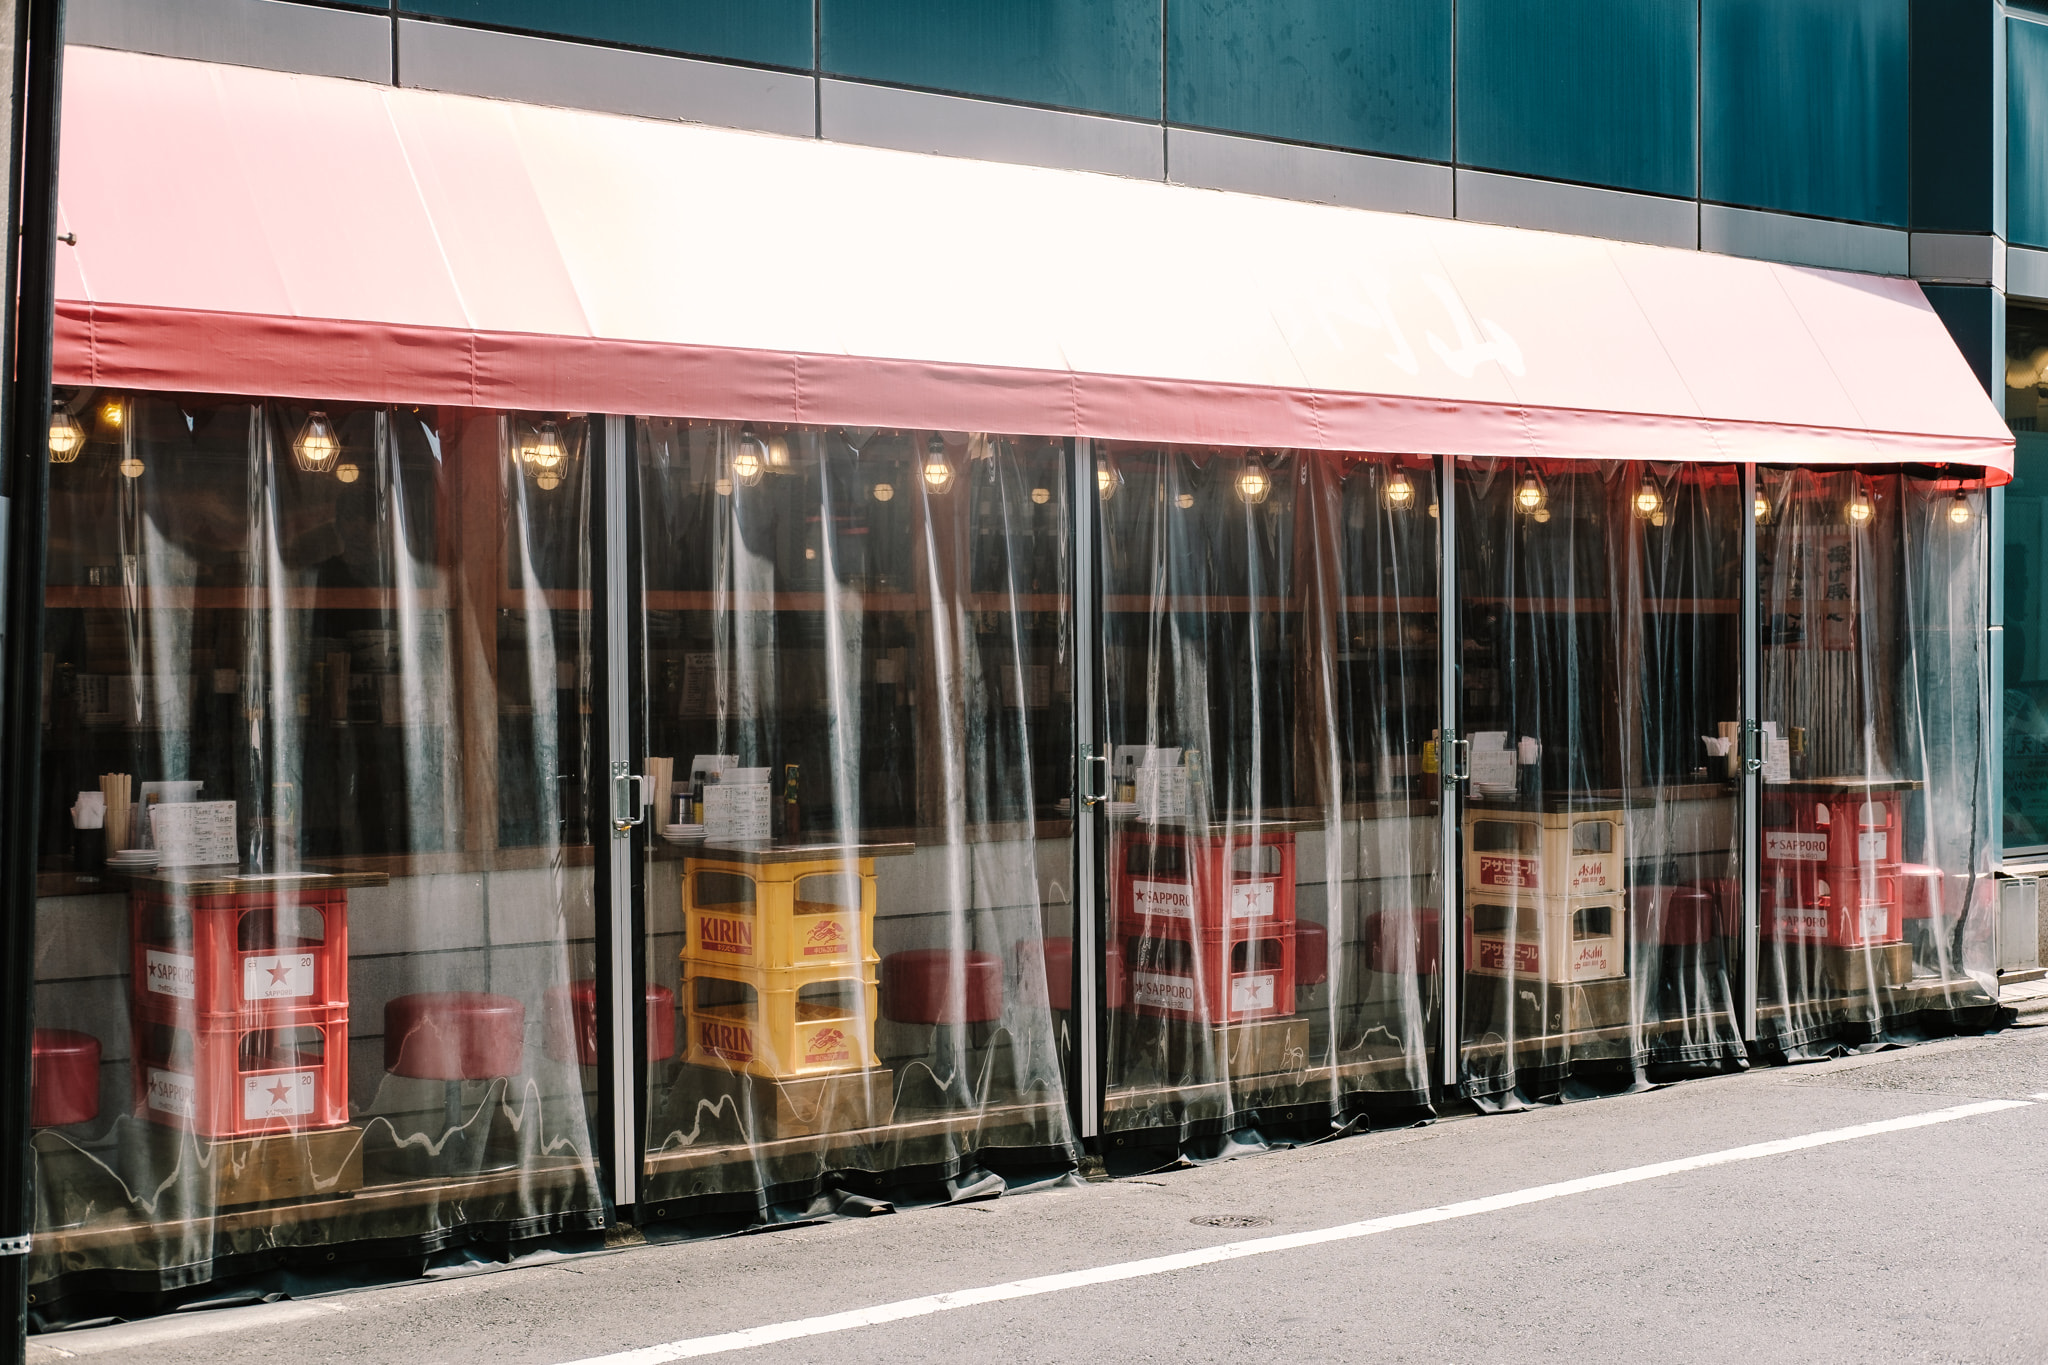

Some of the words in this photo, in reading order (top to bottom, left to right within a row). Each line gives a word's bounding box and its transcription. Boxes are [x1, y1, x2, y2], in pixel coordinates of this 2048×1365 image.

[1779, 840, 1826, 852] SAPPORO
[1481, 858, 1538, 876] アサヒビール
[1578, 861, 1602, 877] Asahi
[1573, 878, 1580, 888] 中
[1598, 875, 1606, 887] 20
[1265, 885, 1273, 893] 20
[700, 917, 752, 946] KIRIN
[1579, 944, 1603, 961] Asahi
[300, 957, 312, 968] 20
[1574, 962, 1581, 972] 中
[1599, 959, 1607, 970] 20
[157, 962, 195, 985] SAPPORO
[1265, 977, 1273, 986] 20
[264, 989, 293, 998] SAPPORO
[1146, 982, 1193, 1000] SAPPORO
[701, 1022, 753, 1052] KIRIN
[301, 1075, 313, 1086] 20
